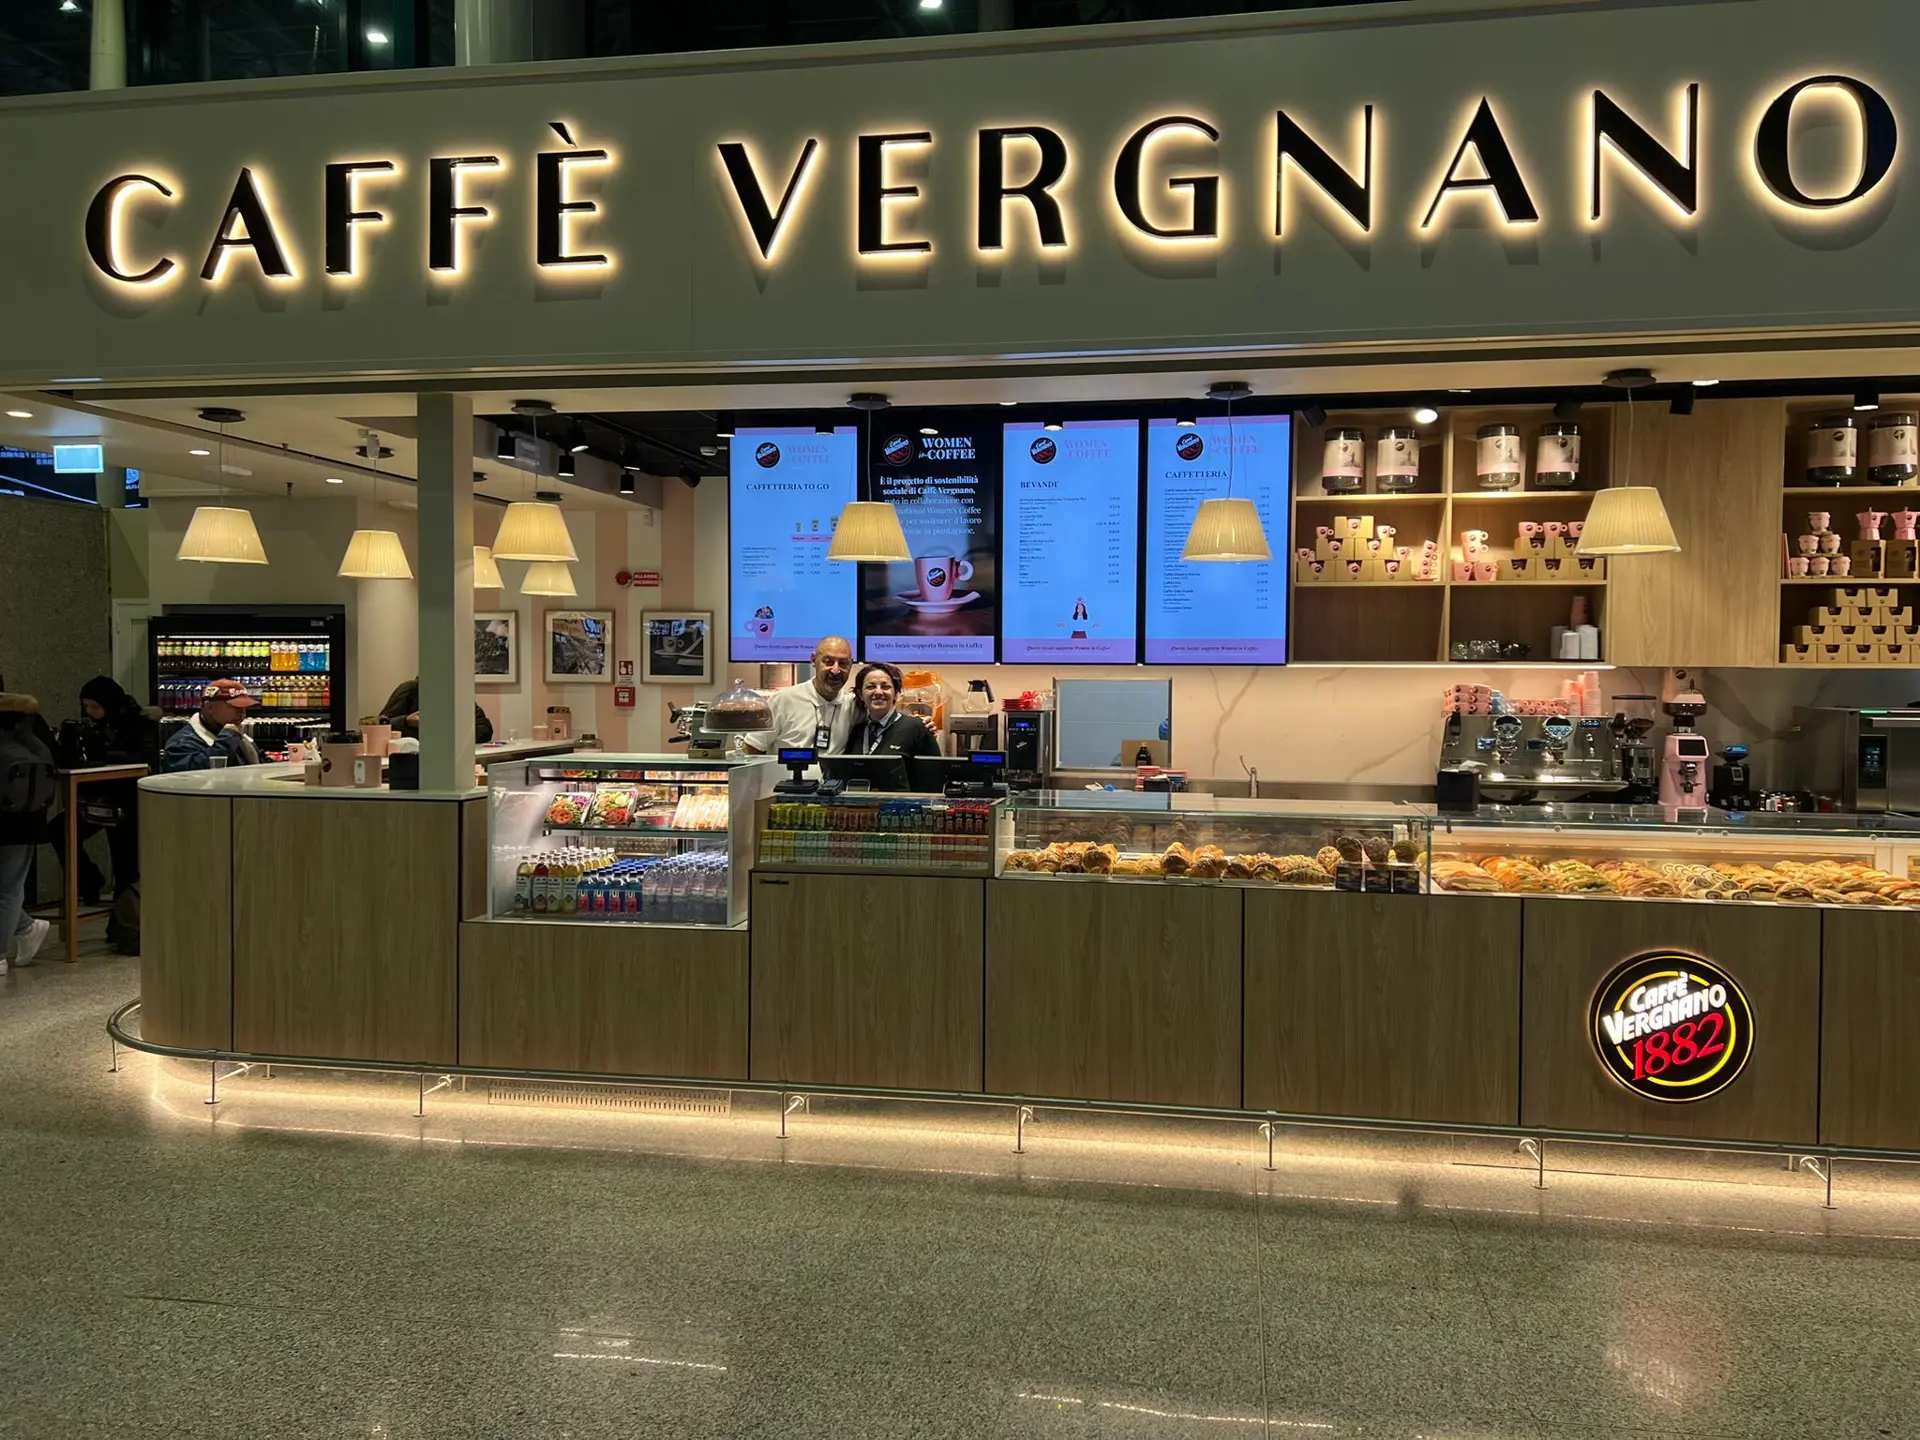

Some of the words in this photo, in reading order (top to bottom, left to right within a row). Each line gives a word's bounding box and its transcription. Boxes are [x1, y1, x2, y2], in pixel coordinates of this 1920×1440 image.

[85, 121, 609, 283] CAFFÈ
[717, 74, 1899, 260] VERGNANO
[922, 437, 972, 448] WOMEN
[1064, 439, 1107, 449] WOMEN
[928, 449, 976, 460] COFFEE
[1165, 470, 1228, 479] CAFFETTERIA
[886, 477, 892, 485] il
[893, 477, 924, 486] progetto
[925, 476, 933, 485] di
[934, 475, 979, 484] sostenibilità
[1020, 481, 1060, 489] BEVANDE
[746, 483, 802, 491] CAFFETTERIA
[804, 483, 815, 491] TO
[817, 483, 830, 491] GO
[882, 487, 907, 495] sociale
[908, 486, 917, 495] di
[917, 486, 937, 495] Caffè
[938, 486, 976, 496] Vergnano,
[959, 507, 982, 515] Coffee
[1603, 983, 1727, 1046] VERGNANO
[1632, 1012, 1725, 1081] 1882
